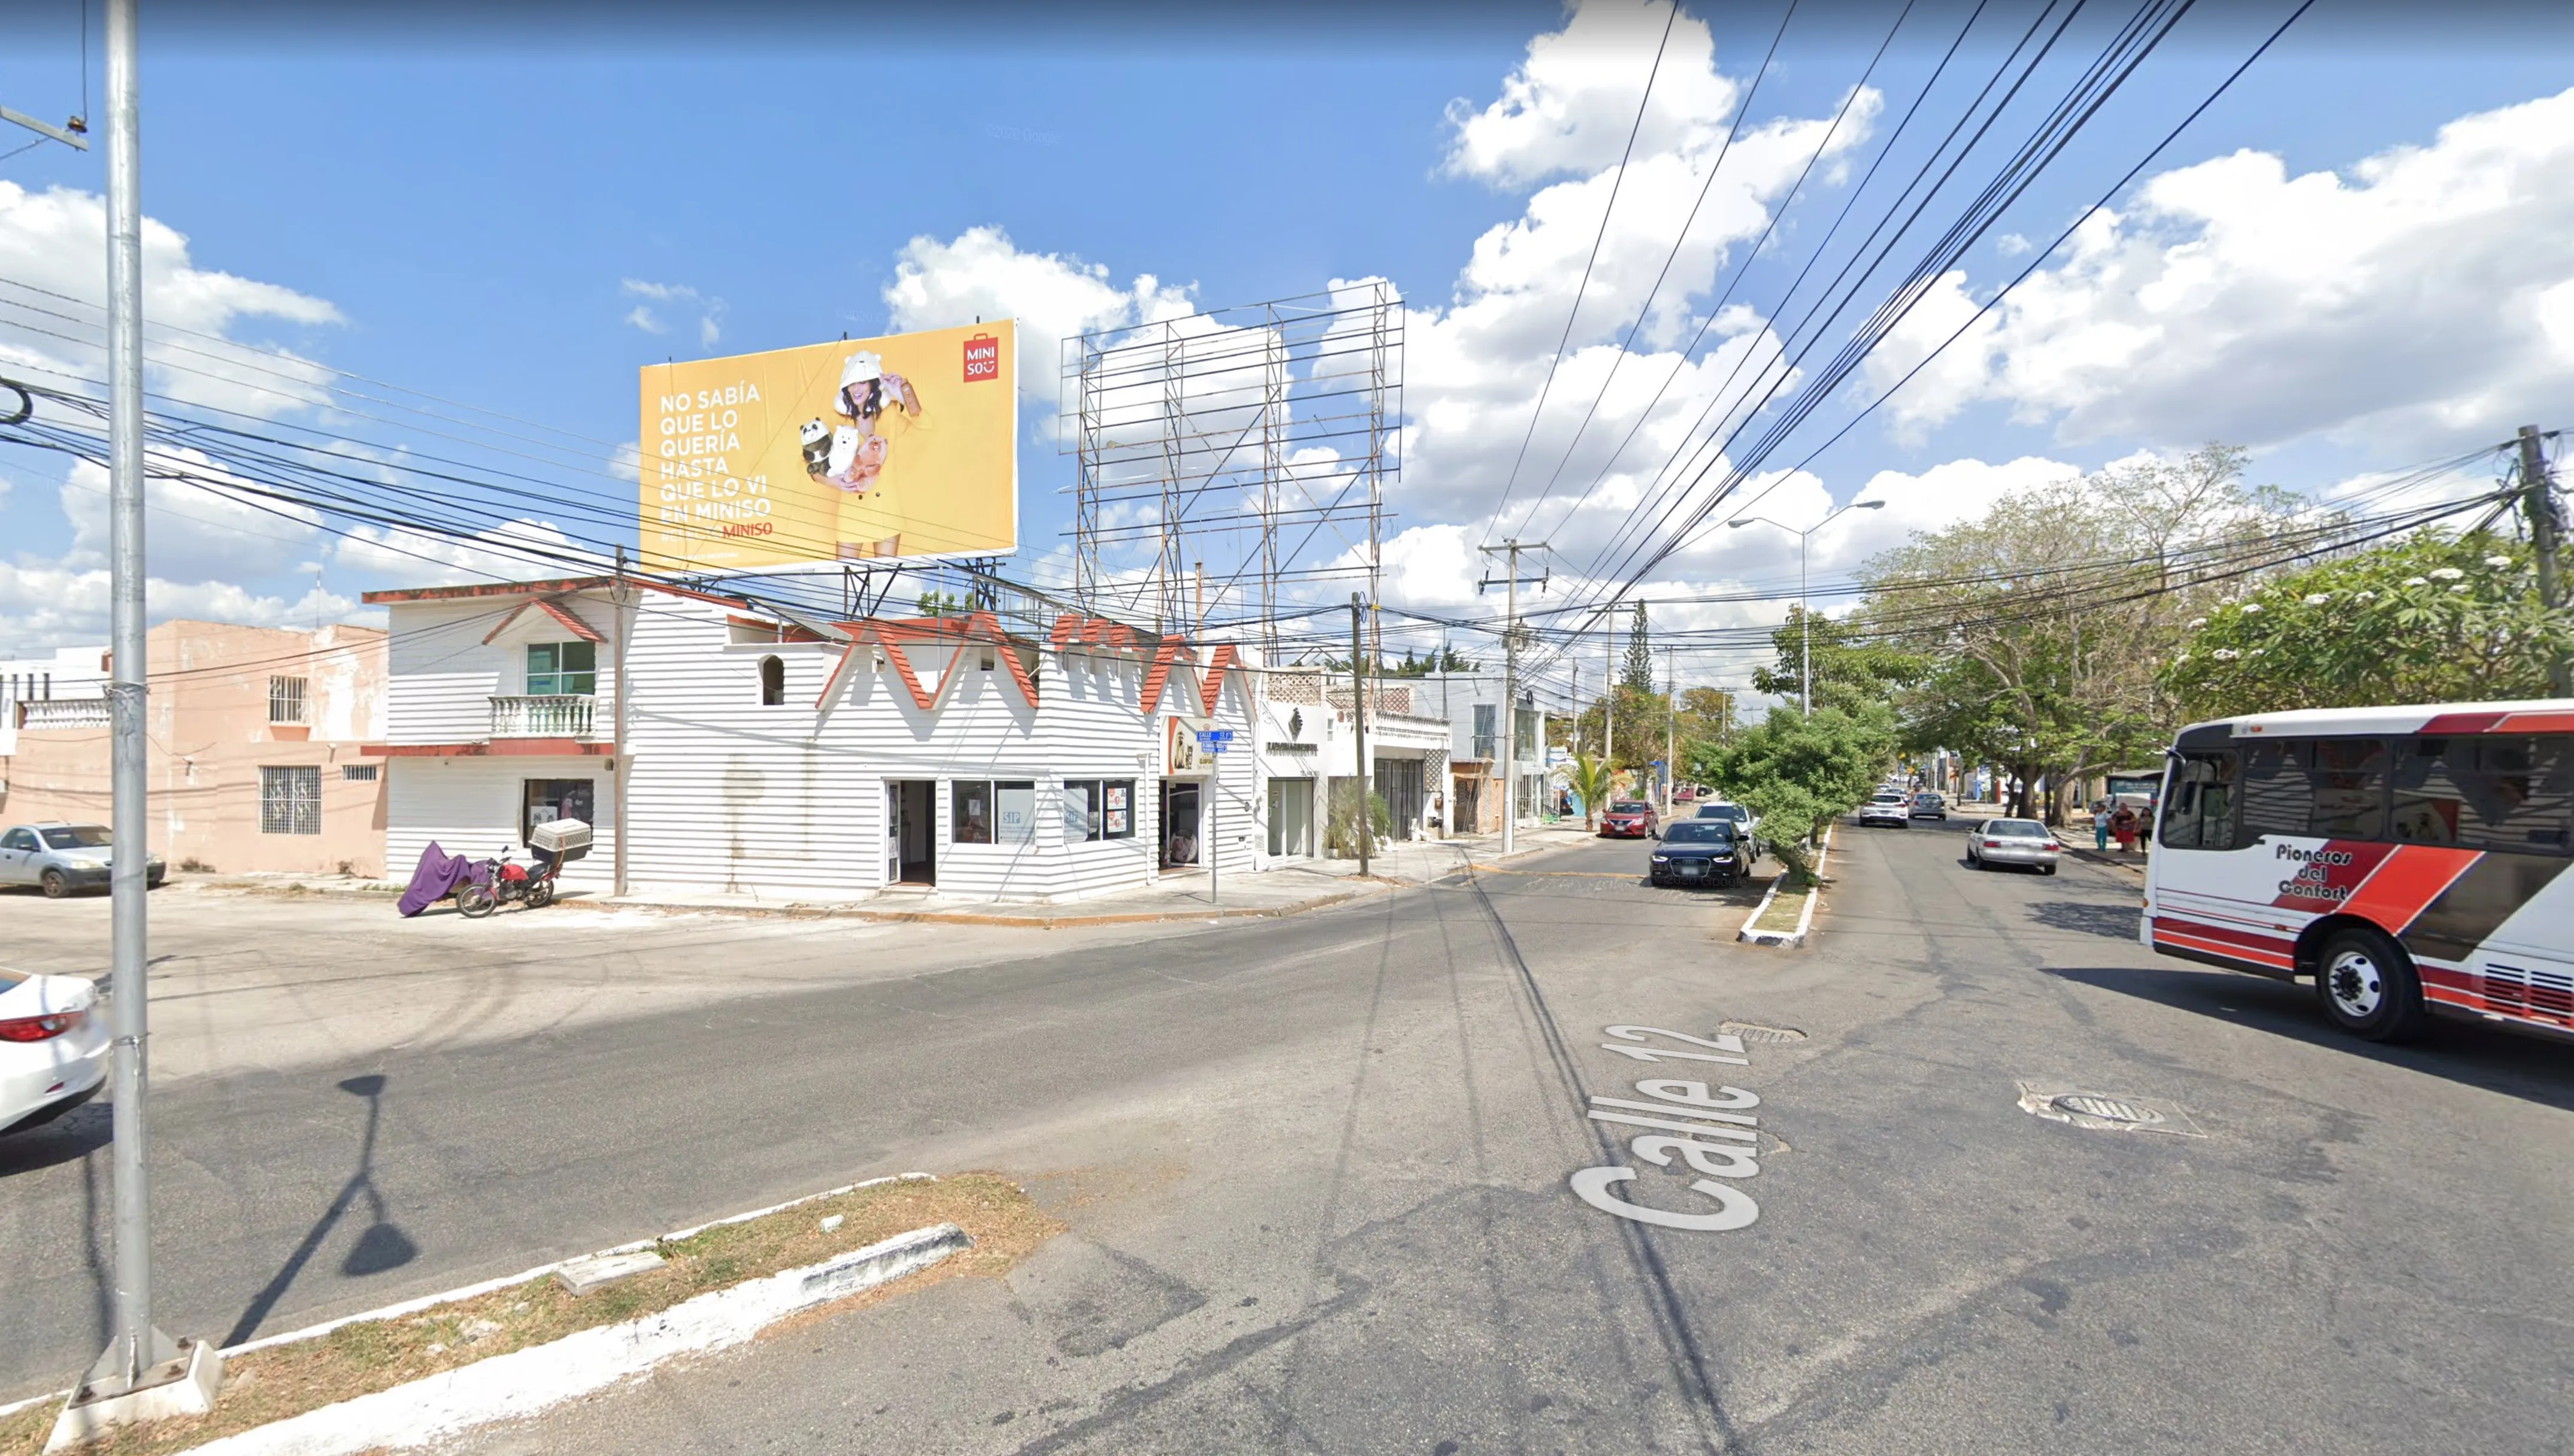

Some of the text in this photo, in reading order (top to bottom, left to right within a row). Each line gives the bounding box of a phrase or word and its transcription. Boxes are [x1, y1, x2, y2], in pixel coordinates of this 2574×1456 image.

[967, 346, 994, 361] MINI
[661, 380, 761, 414] NO SABÍA
[661, 410, 738, 435] QUE LO
[661, 428, 740, 457] QUERÍA
[661, 457, 729, 480] HASTA
[661, 475, 767, 502] QUE LO VI
[661, 498, 771, 524] EN MINISO
[1003, 812, 1020, 823] SIP
[1066, 811, 1078, 822] SIP
[2276, 844, 2352, 865] Pioneros
[2297, 865, 2327, 882] del
[2278, 879, 2348, 900] Confort
